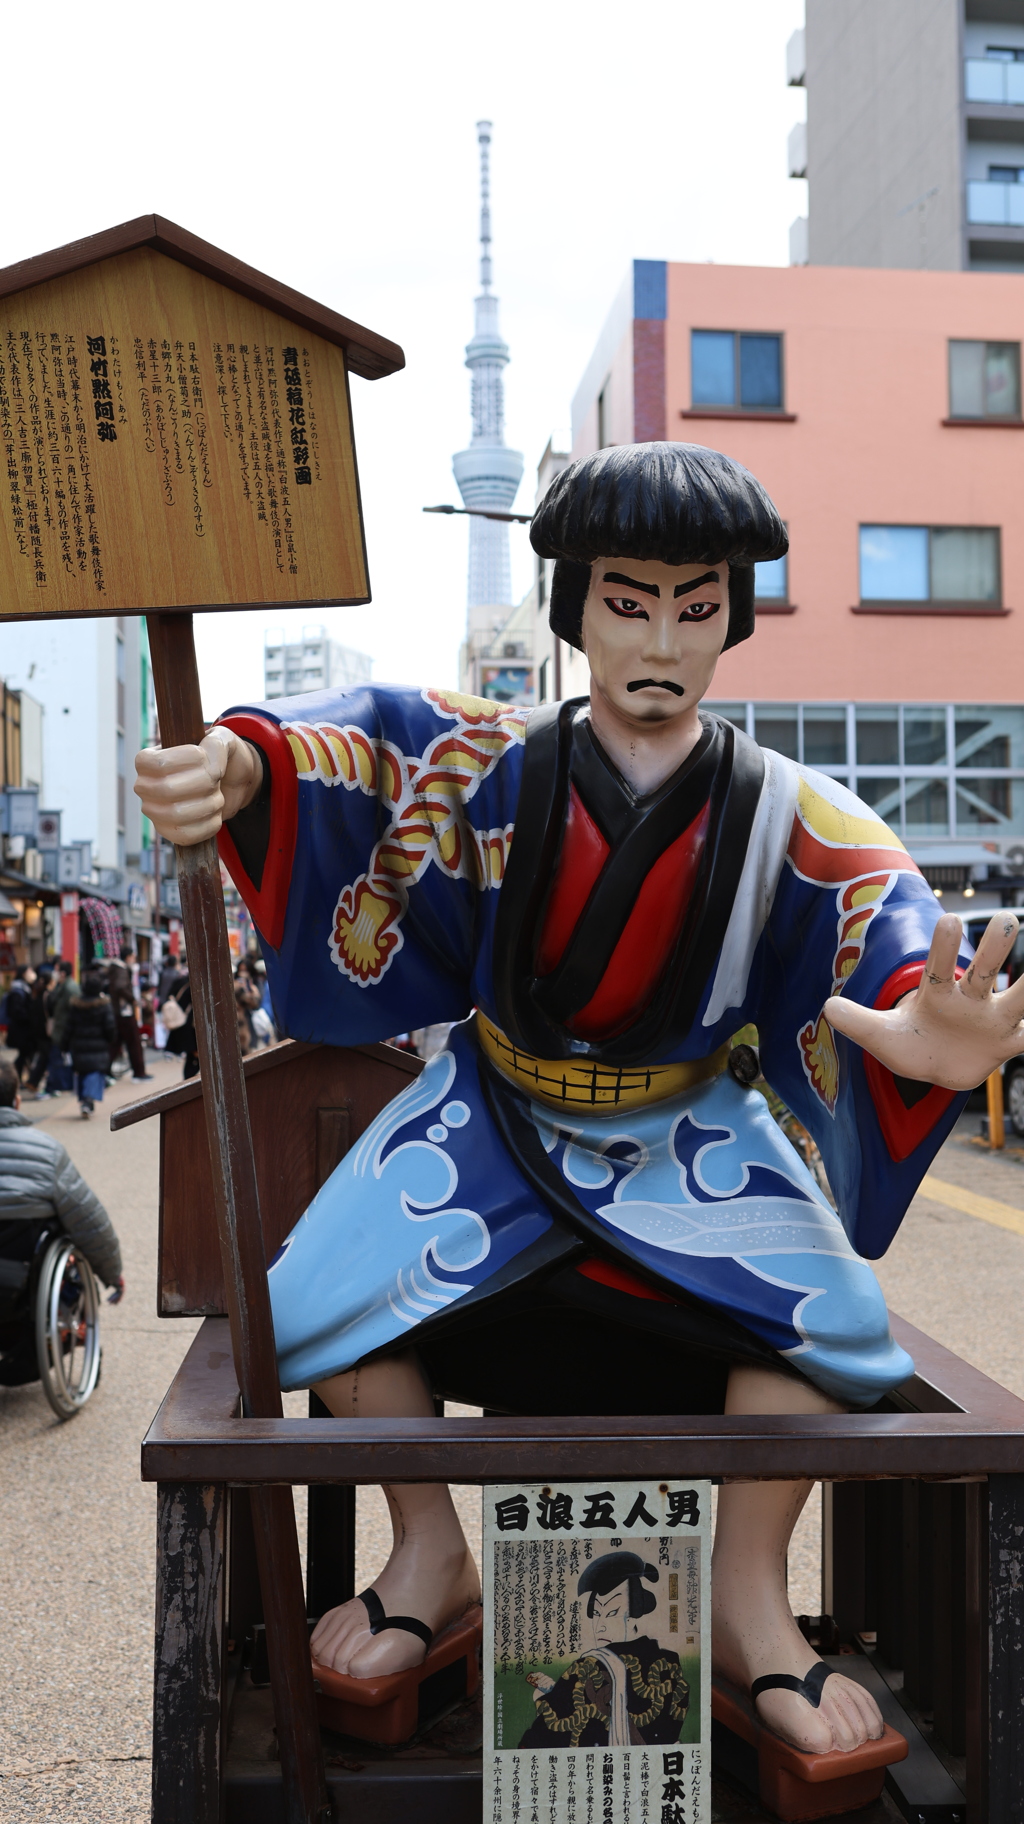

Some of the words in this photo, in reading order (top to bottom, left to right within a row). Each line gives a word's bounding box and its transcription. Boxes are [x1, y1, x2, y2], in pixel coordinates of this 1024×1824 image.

[110, 336, 127, 424] かわたけもくあみ
[213, 343, 234, 443] 注意深く探して下さい。
[494, 1489, 701, 1532] 白浪五人男
[492, 1756, 503, 1824] 年六十余州に隠
[530, 1754, 539, 1824] をかけて宿々で義
[566, 1755, 577, 1824] 四の年から親に放
